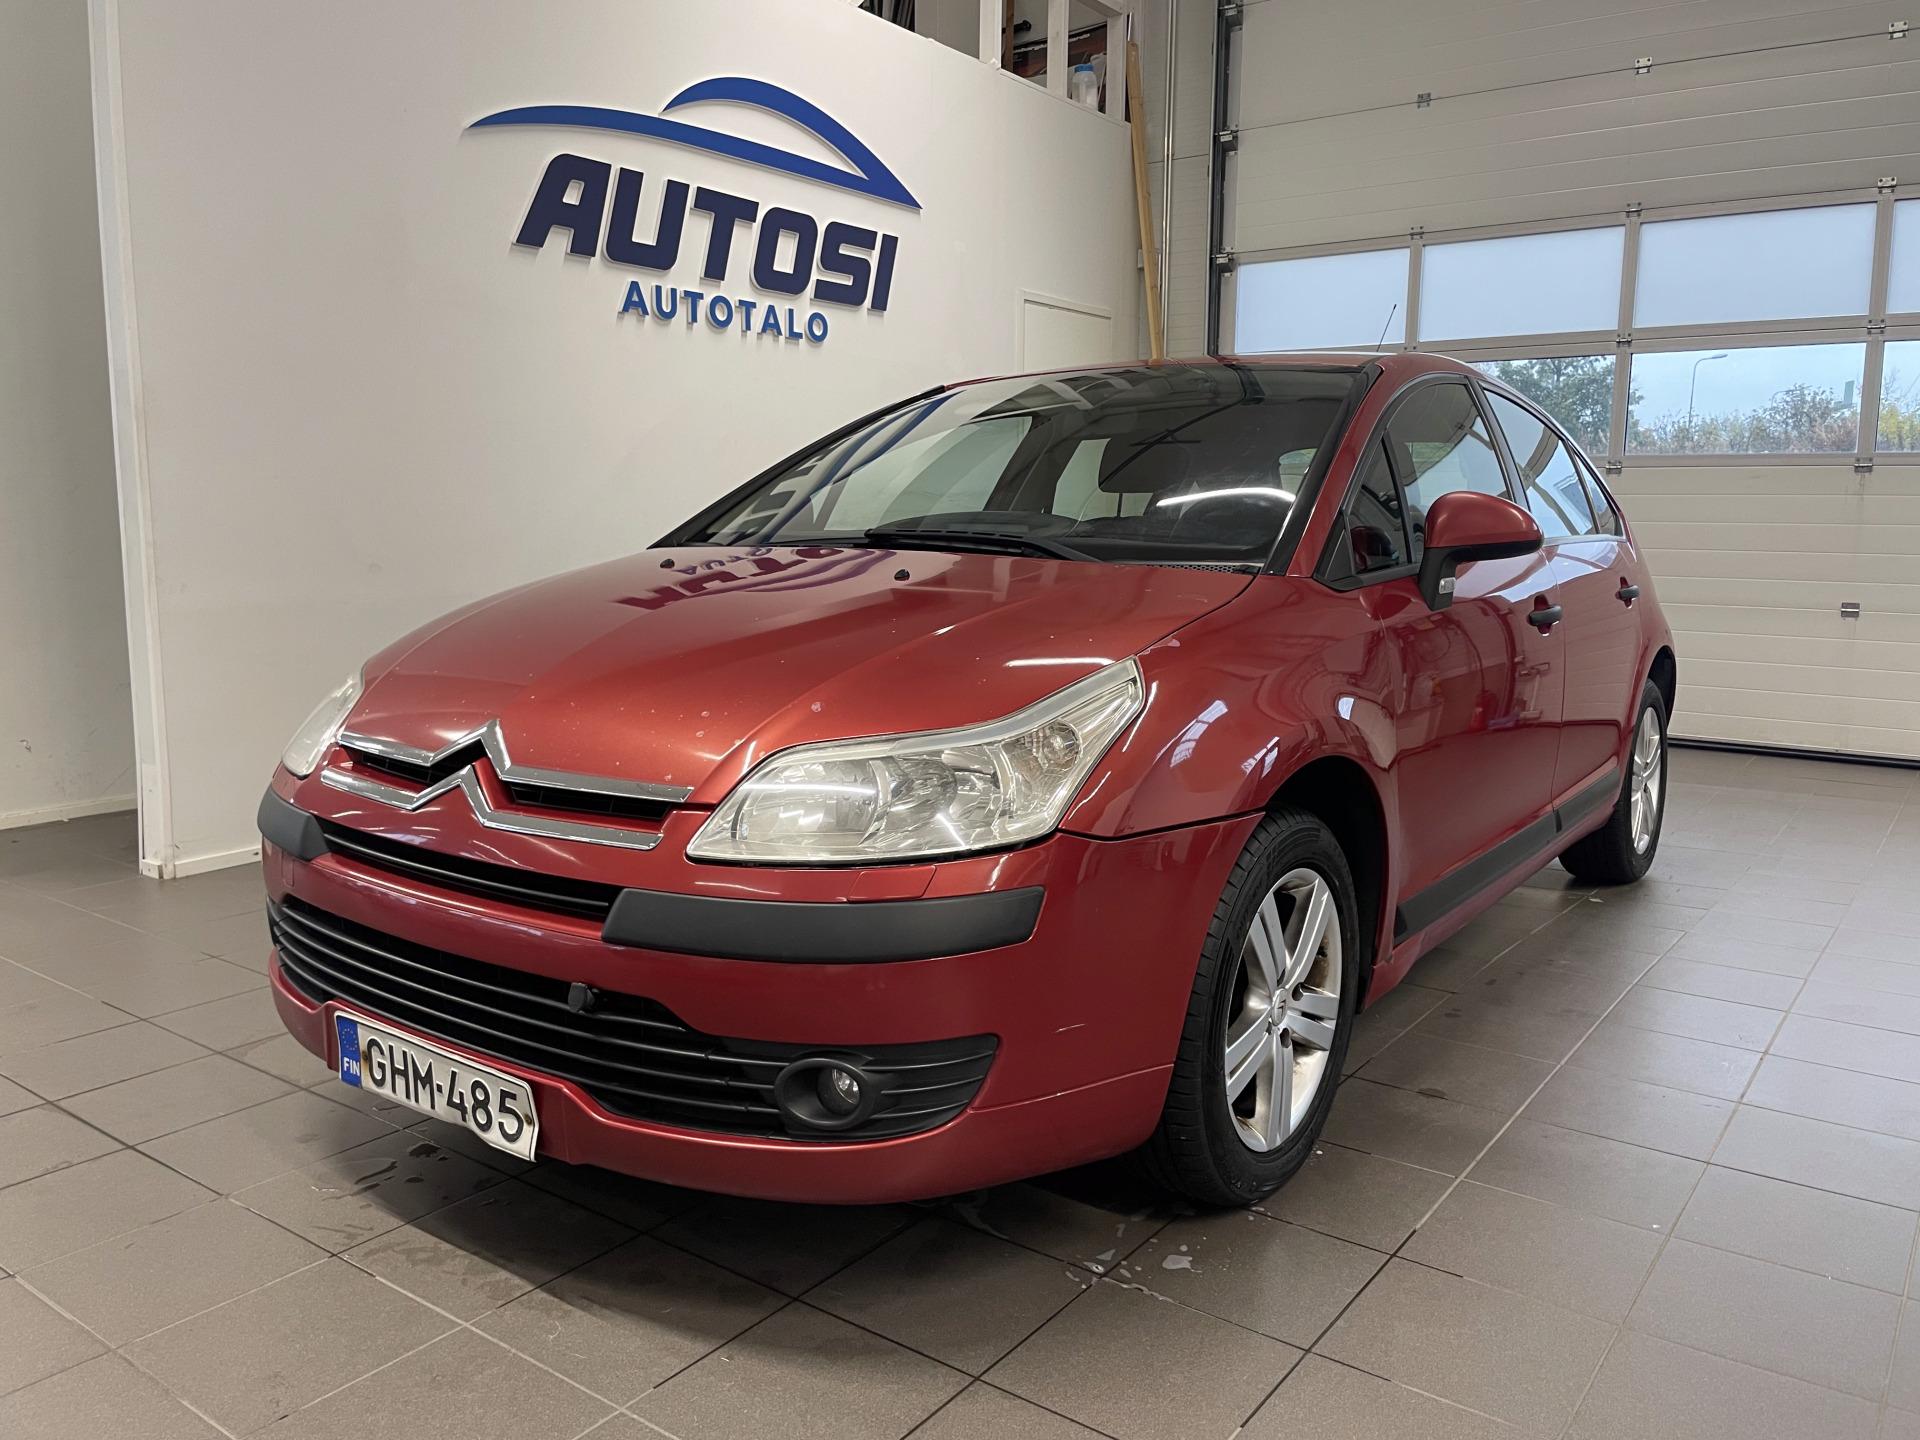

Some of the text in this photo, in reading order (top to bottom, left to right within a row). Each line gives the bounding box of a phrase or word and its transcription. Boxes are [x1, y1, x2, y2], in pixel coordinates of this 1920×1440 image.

[515, 153, 899, 312] AUTOSI
[620, 280, 829, 343] AUTOTALO
[343, 1056, 360, 1076] FIN
[366, 1037, 525, 1143] GHM-485
